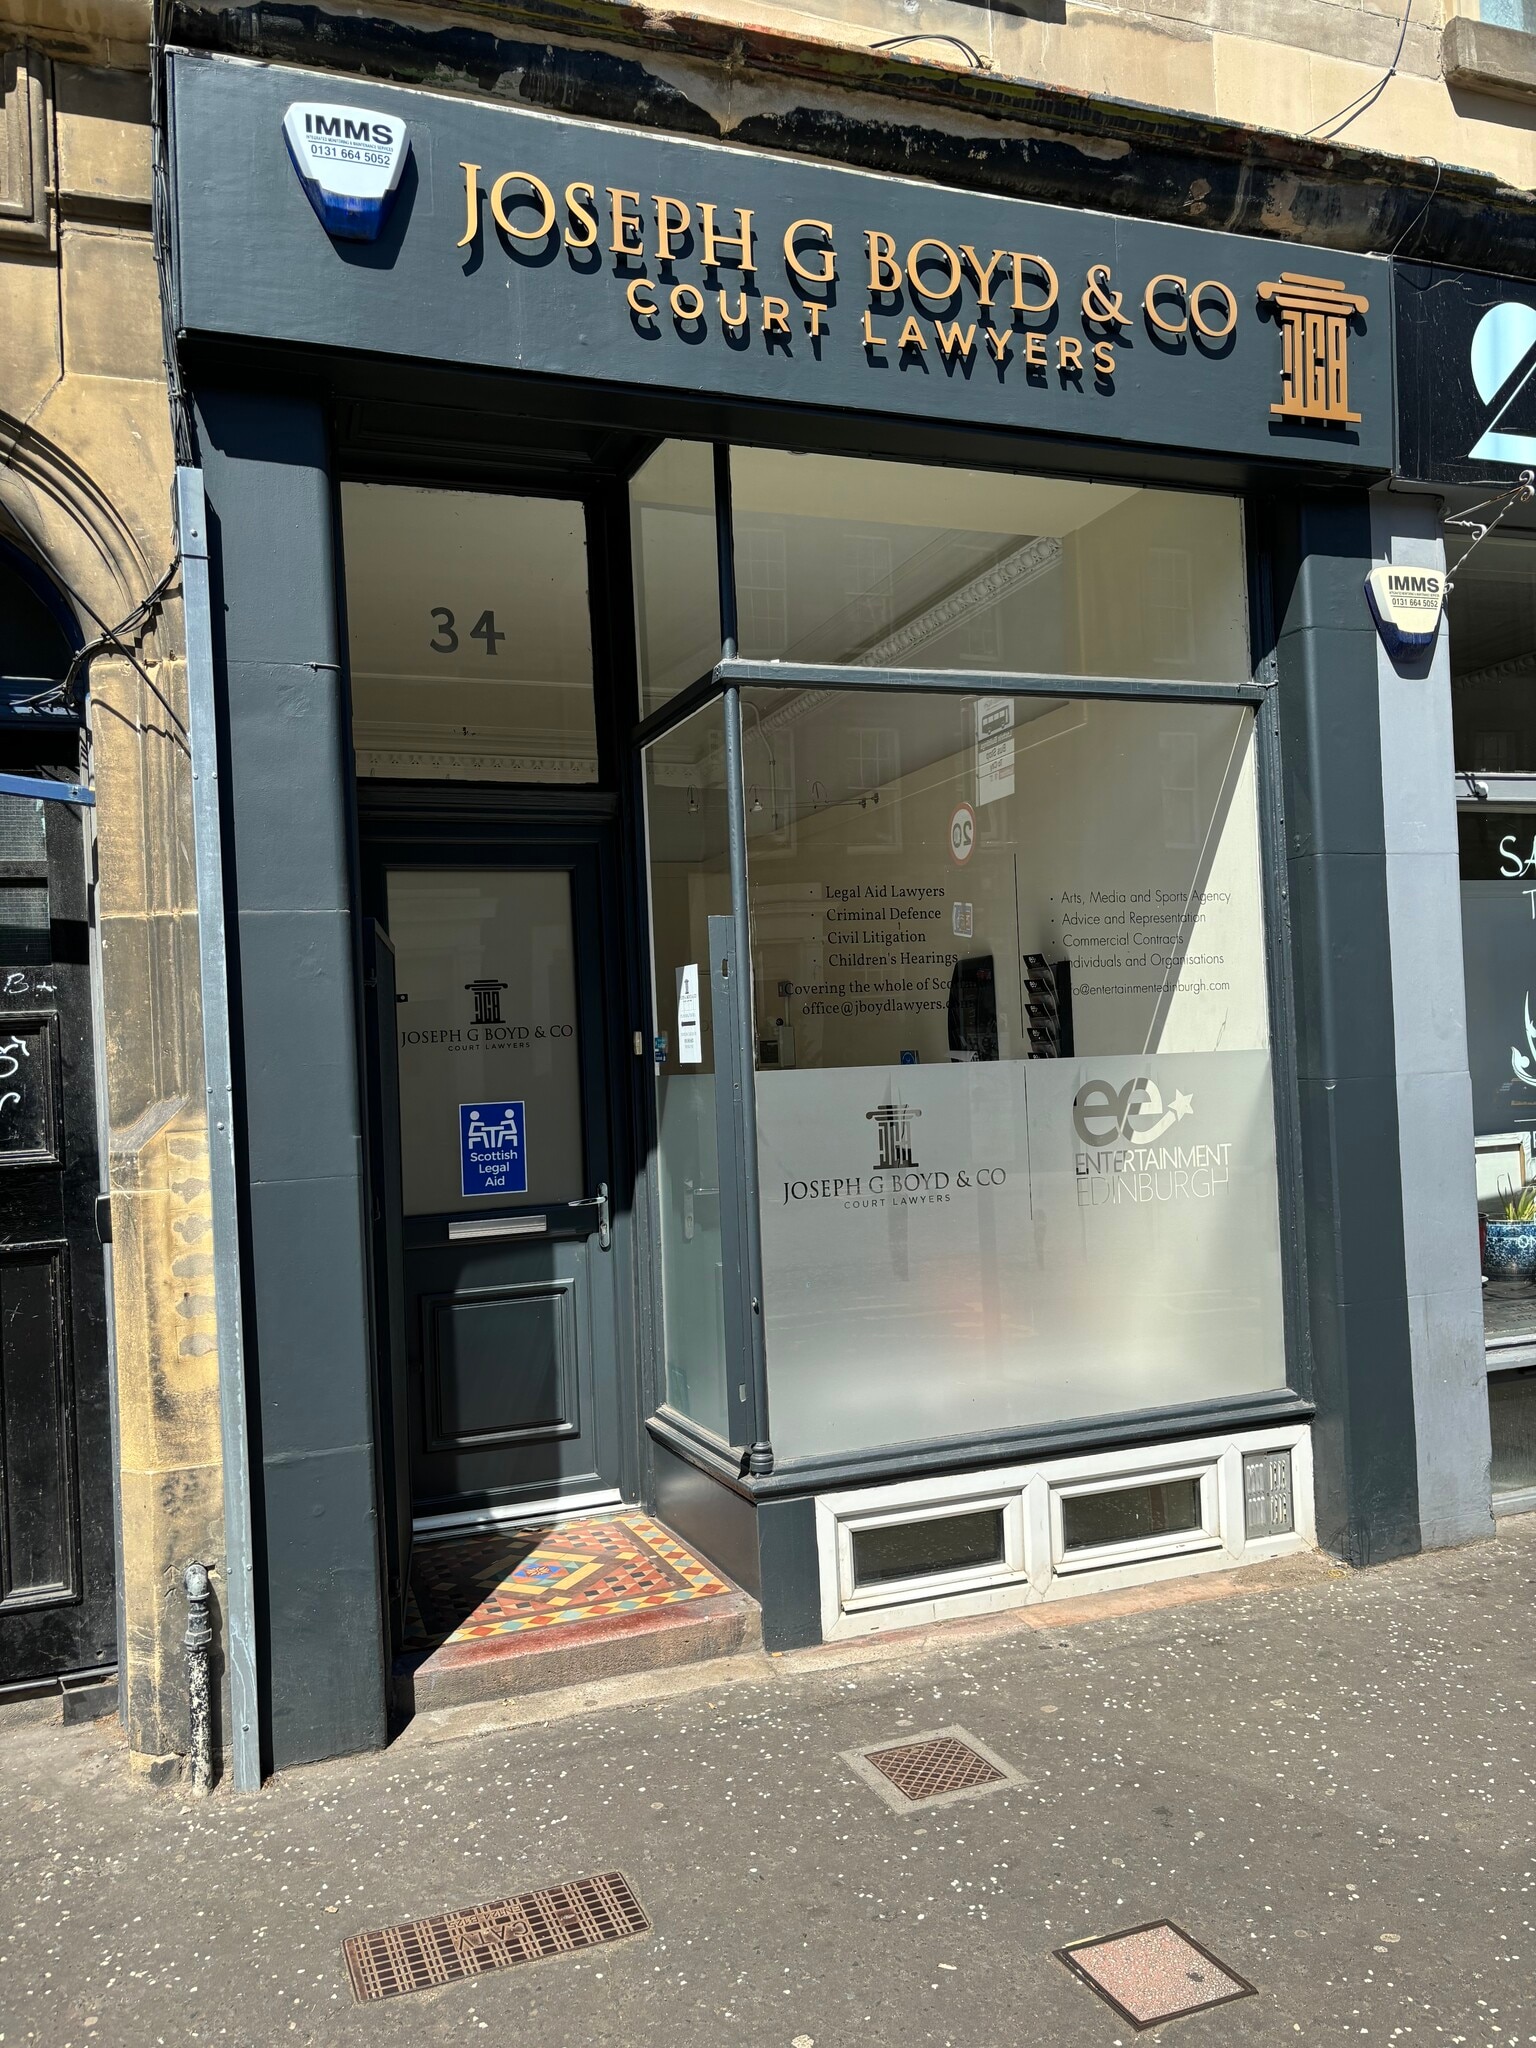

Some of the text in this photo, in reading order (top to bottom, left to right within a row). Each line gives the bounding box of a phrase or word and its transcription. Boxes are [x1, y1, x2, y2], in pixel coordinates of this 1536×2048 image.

[304, 113, 394, 145] IMMS
[311, 144, 391, 166] 0131 664 5052
[456, 161, 1239, 338] JOSEPH G BOYD & CO
[626, 277, 1117, 375] COURT LAWYERS
[1388, 575, 1440, 593] IMMS
[1392, 597, 1438, 608] 0131 664 5052
[429, 606, 506, 656] 34
[826, 885, 945, 901] Legal Aid Lawyers
[1061, 889, 1232, 906] Arts, Media and Sports Agency
[826, 907, 942, 921] Criminal Defence
[1062, 911, 1206, 927] Advice and Representation
[827, 930, 926, 946] Civil Litigation
[1062, 932, 1184, 947] Commercial Contracts
[828, 952, 958, 968] Children's Hearings
[1125, 954, 1147, 967] and
[1150, 953, 1225, 969] Organisations
[785, 982, 846, 997] Covering
[850, 980, 871, 993] the
[873, 979, 914, 992] whole
[916, 977, 930, 991] of
[1071, 979, 1230, 996] o@entertainmentedinburgh.com
[401, 1024, 573, 1048] JOSEPH G BOYD & CO
[447, 1042, 531, 1052] COURT LAWYERS
[470, 1149, 518, 1162] Scottish
[1075, 1143, 1232, 1175] ENTERTAINMENT
[479, 1161, 510, 1175] Legal
[485, 1175, 505, 1187] Aid
[783, 1167, 1007, 1206] JOSEPH G BOYD & CO
[1076, 1167, 1230, 1207] EDINBURGH
[844, 1193, 951, 1210] COURT LAWYERS
